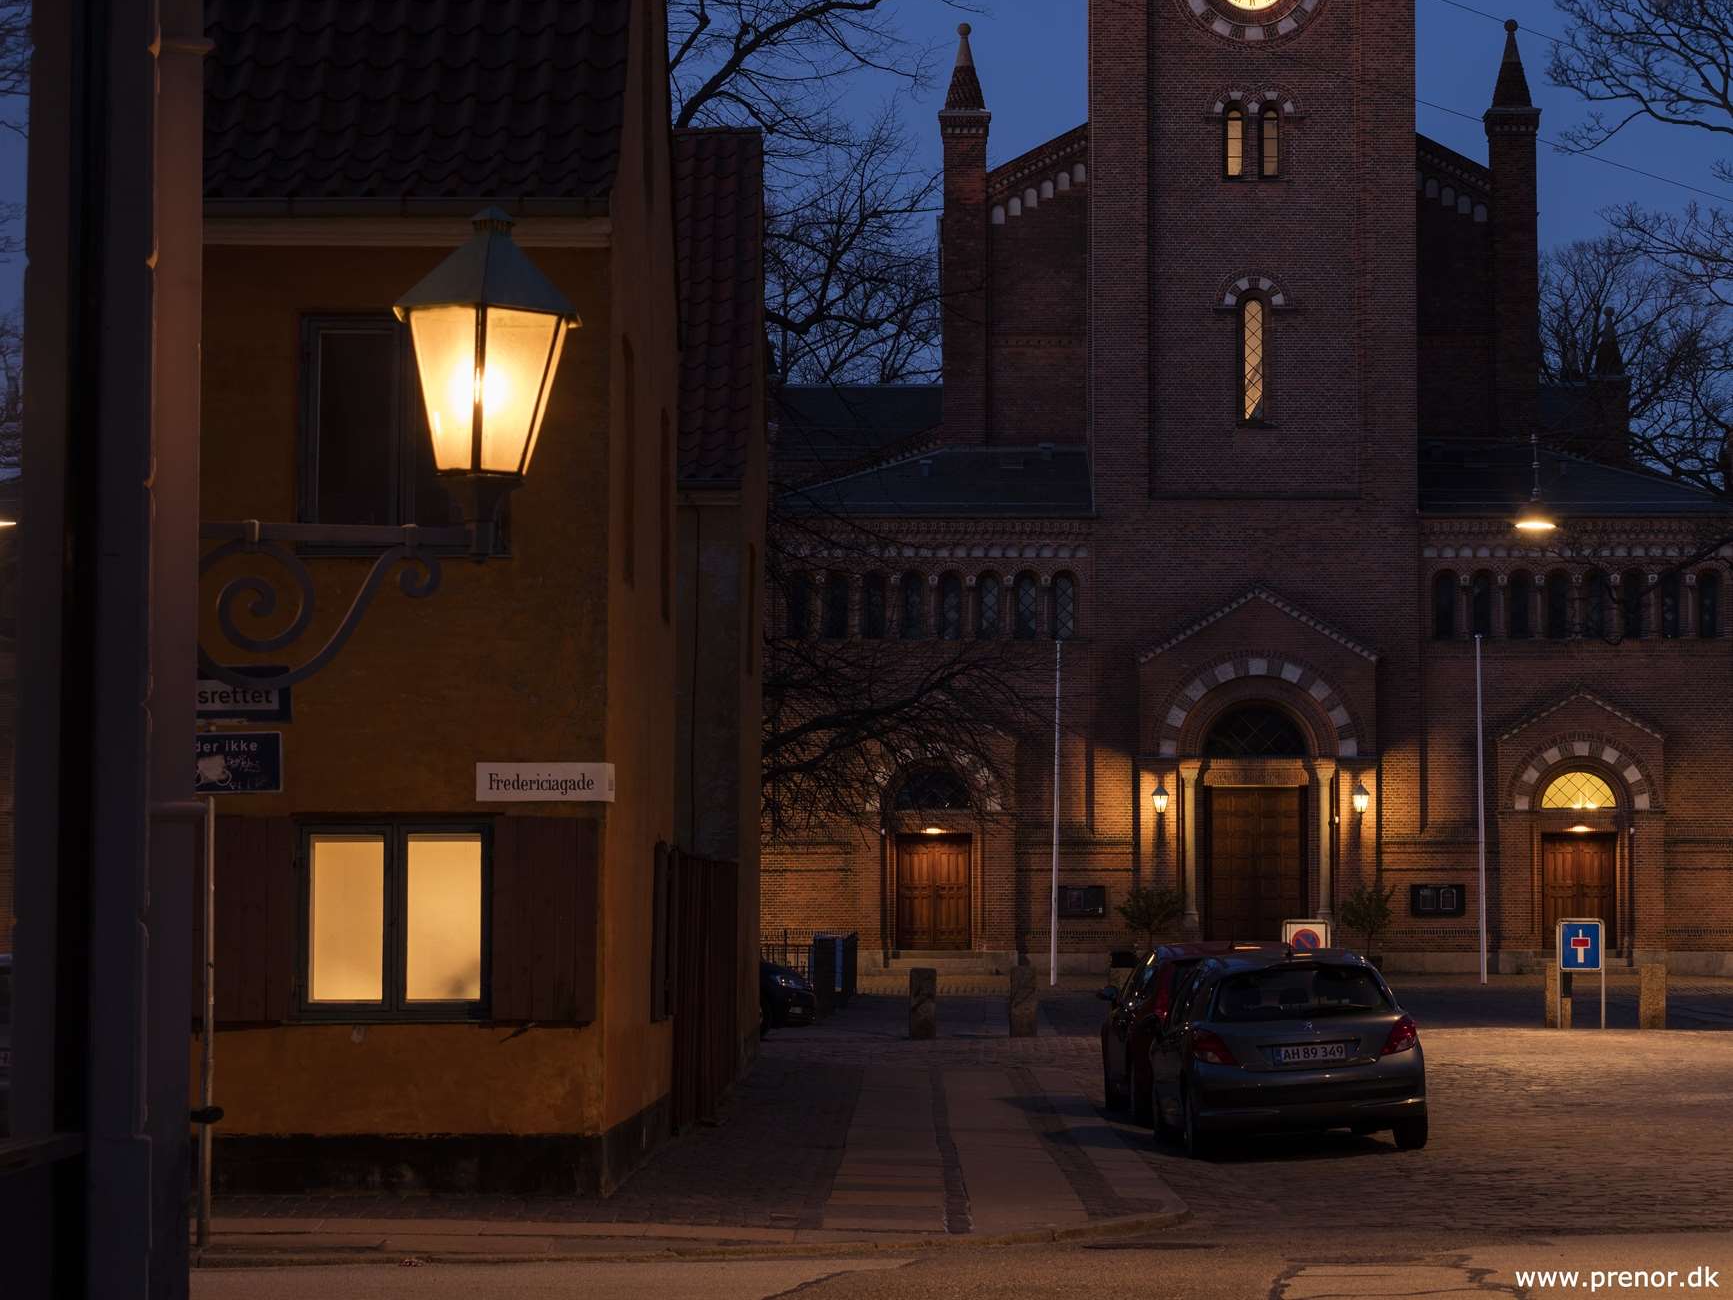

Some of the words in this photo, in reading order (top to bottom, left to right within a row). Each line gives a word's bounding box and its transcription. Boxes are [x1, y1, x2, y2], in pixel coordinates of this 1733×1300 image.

[488, 773, 594, 795] Fredericiagade
[1283, 1049, 1300, 1061] AH
[1303, 1047, 1318, 1059] 89
[1320, 1045, 1343, 1057] 349
